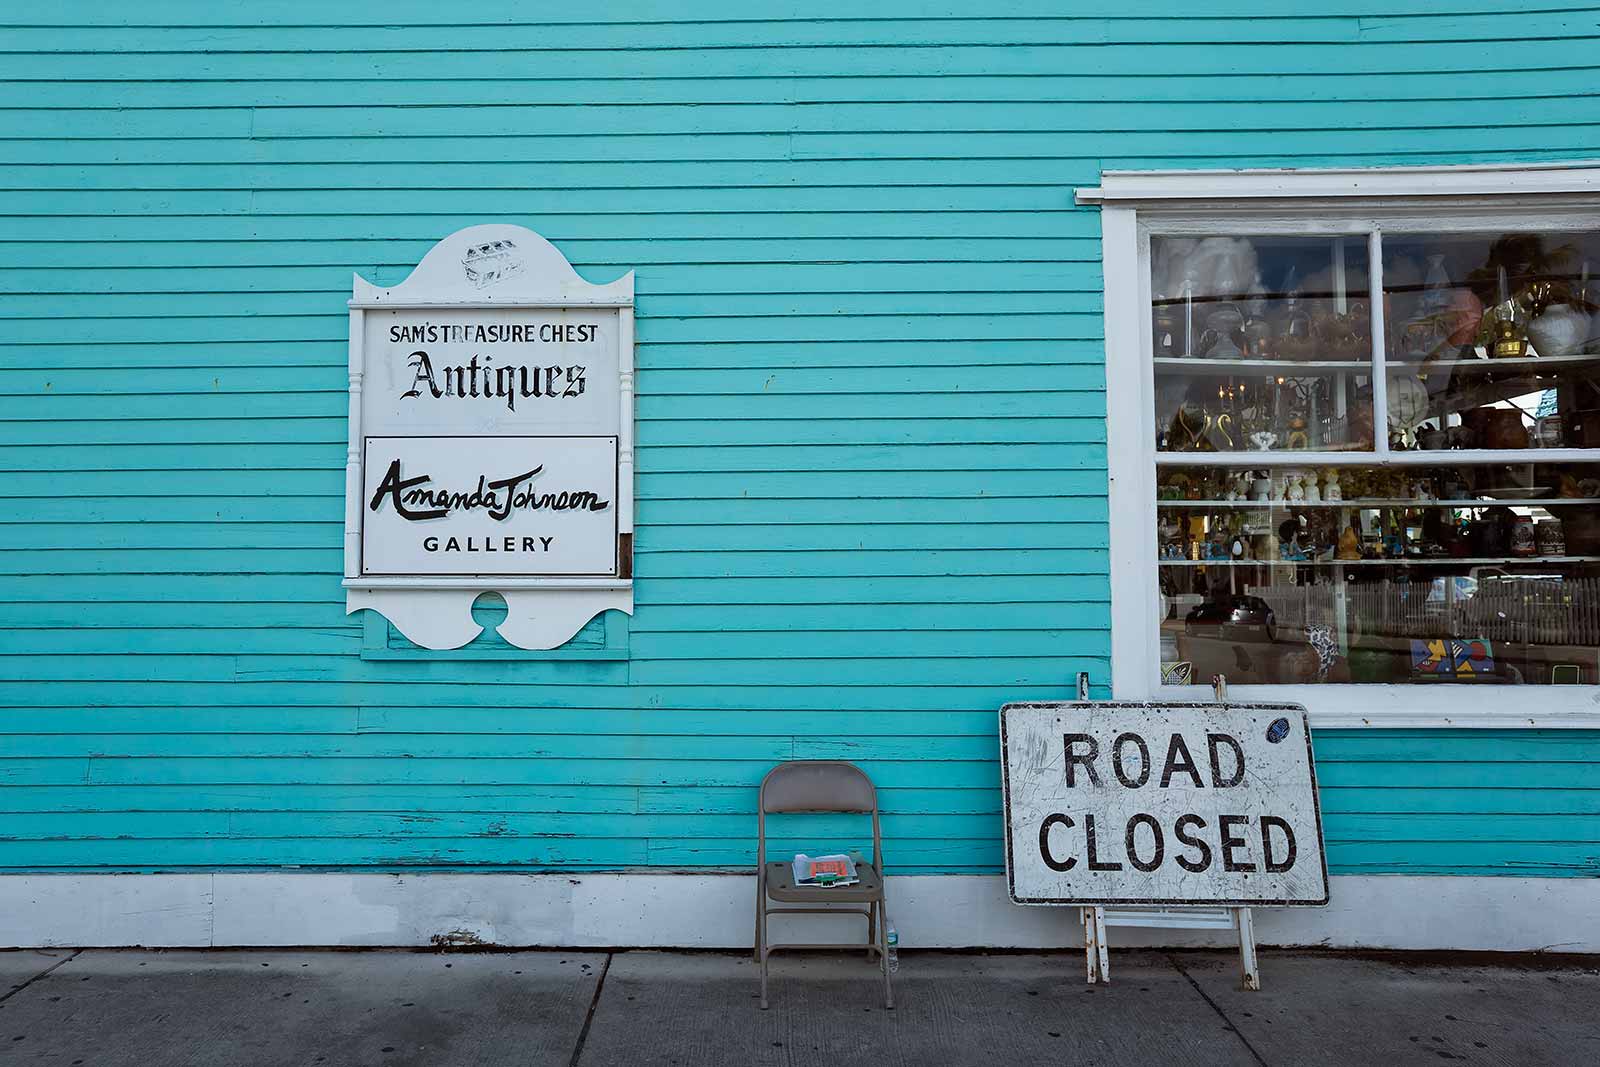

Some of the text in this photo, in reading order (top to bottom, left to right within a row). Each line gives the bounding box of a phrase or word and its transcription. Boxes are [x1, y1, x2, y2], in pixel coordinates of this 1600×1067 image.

[390, 321, 438, 343] SAM'S
[539, 323, 599, 343] CHEST
[400, 350, 587, 412] Antiques
[369, 458, 610, 521] Amanda Johnson
[423, 536, 554, 552] GALLERY
[1062, 731, 1247, 789] ROAD
[1038, 812, 1297, 873] CLOSED
